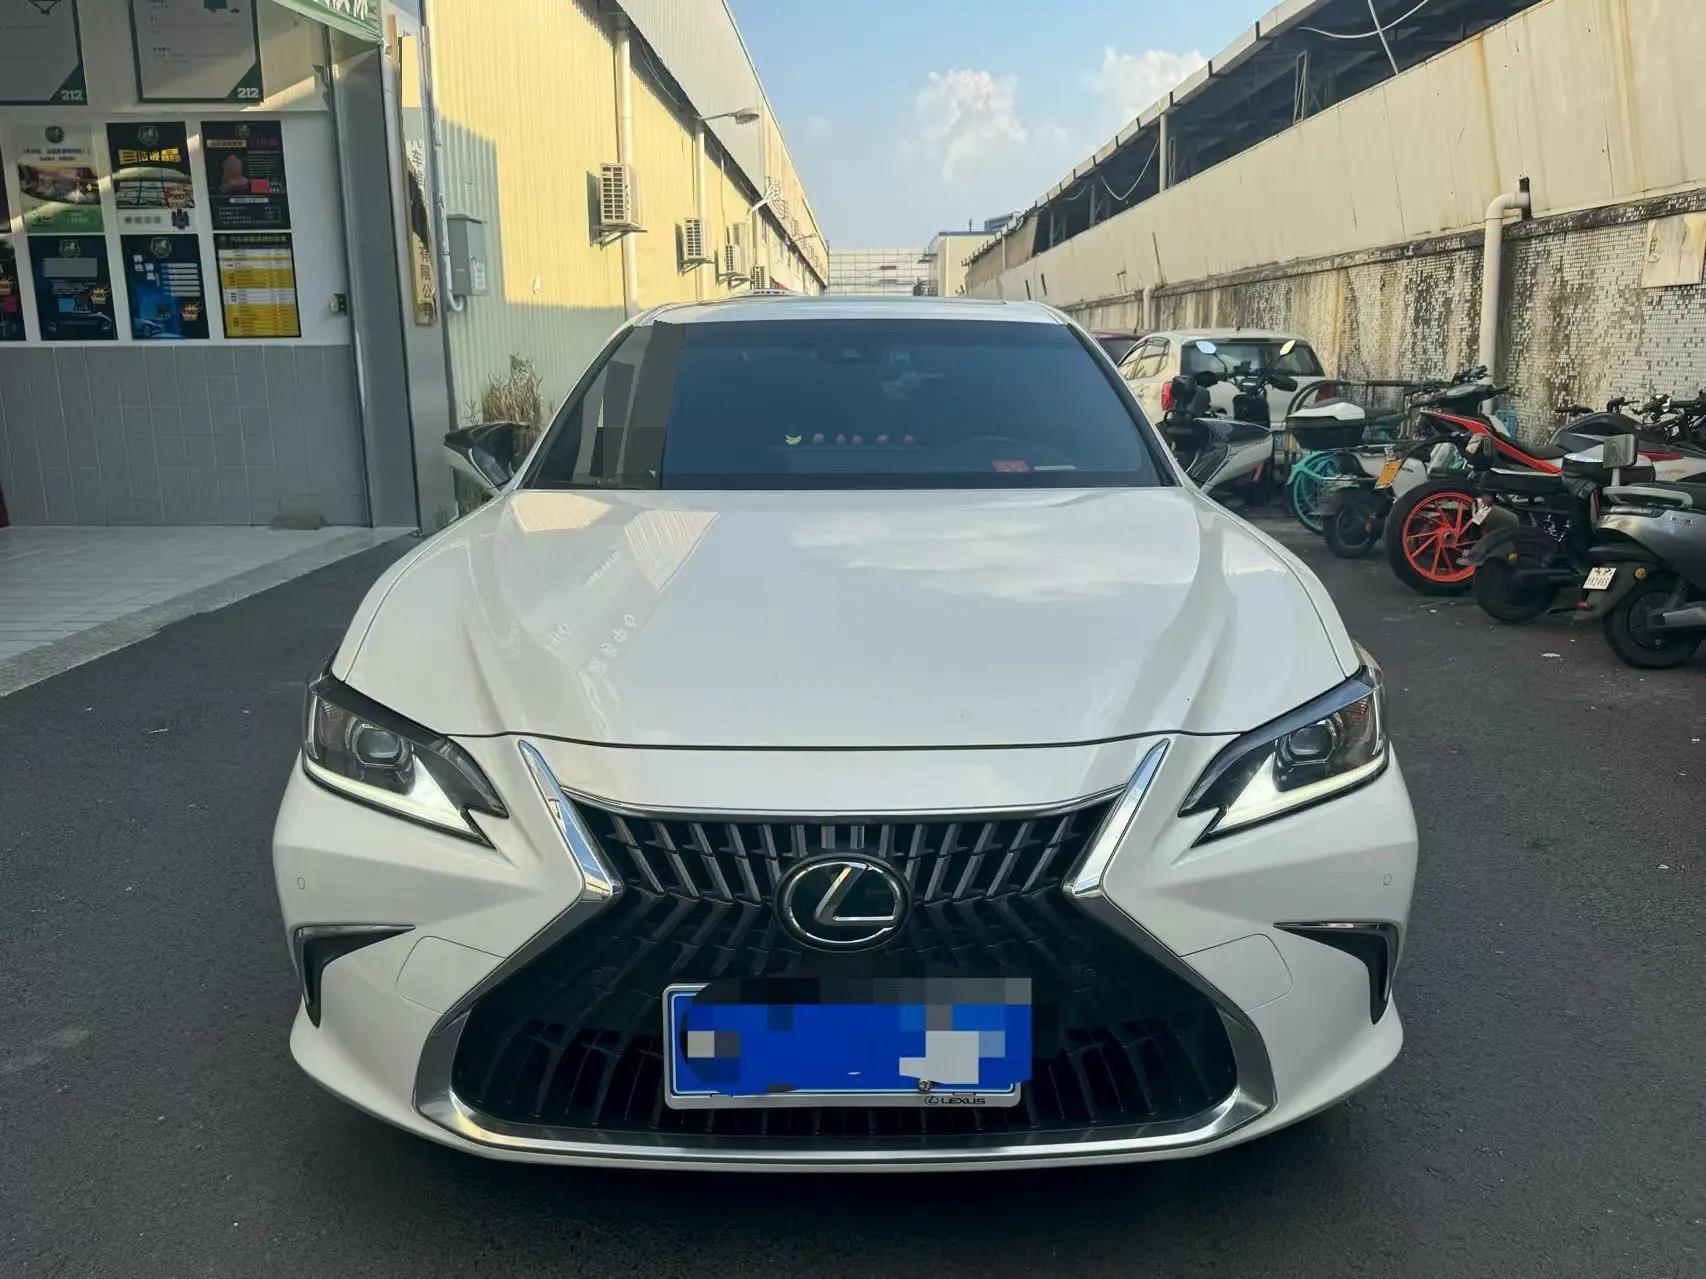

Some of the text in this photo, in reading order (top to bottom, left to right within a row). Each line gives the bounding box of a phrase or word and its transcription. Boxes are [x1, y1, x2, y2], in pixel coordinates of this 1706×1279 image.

[61, 90, 83, 101] 212
[238, 87, 260, 99] 212
[941, 1097, 986, 1105] LEXUS
